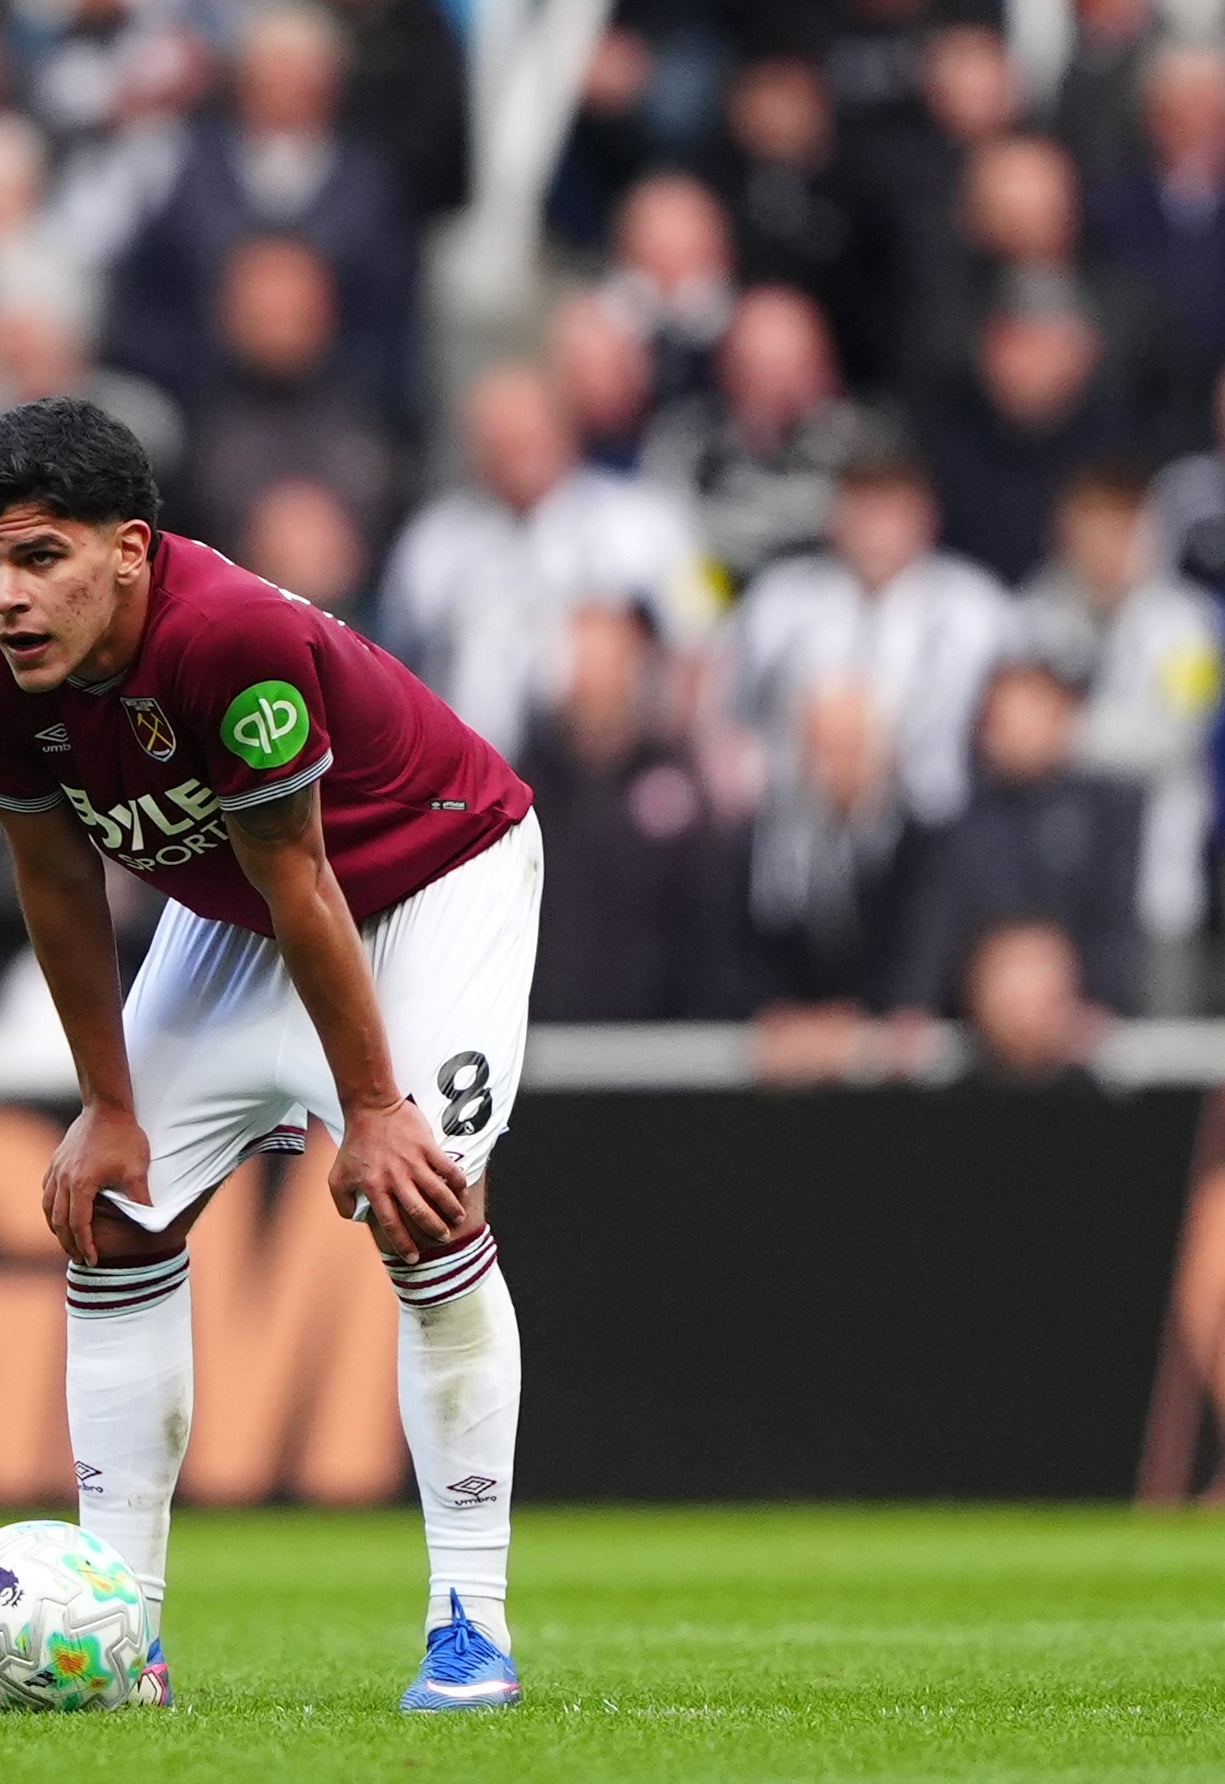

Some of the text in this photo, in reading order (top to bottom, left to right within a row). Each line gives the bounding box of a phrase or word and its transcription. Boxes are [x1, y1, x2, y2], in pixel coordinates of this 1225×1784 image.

[42, 743, 72, 753] umb
[118, 813, 229, 872] SPORT
[437, 1051, 493, 1136] 8
[454, 1494, 497, 1506] umbro
